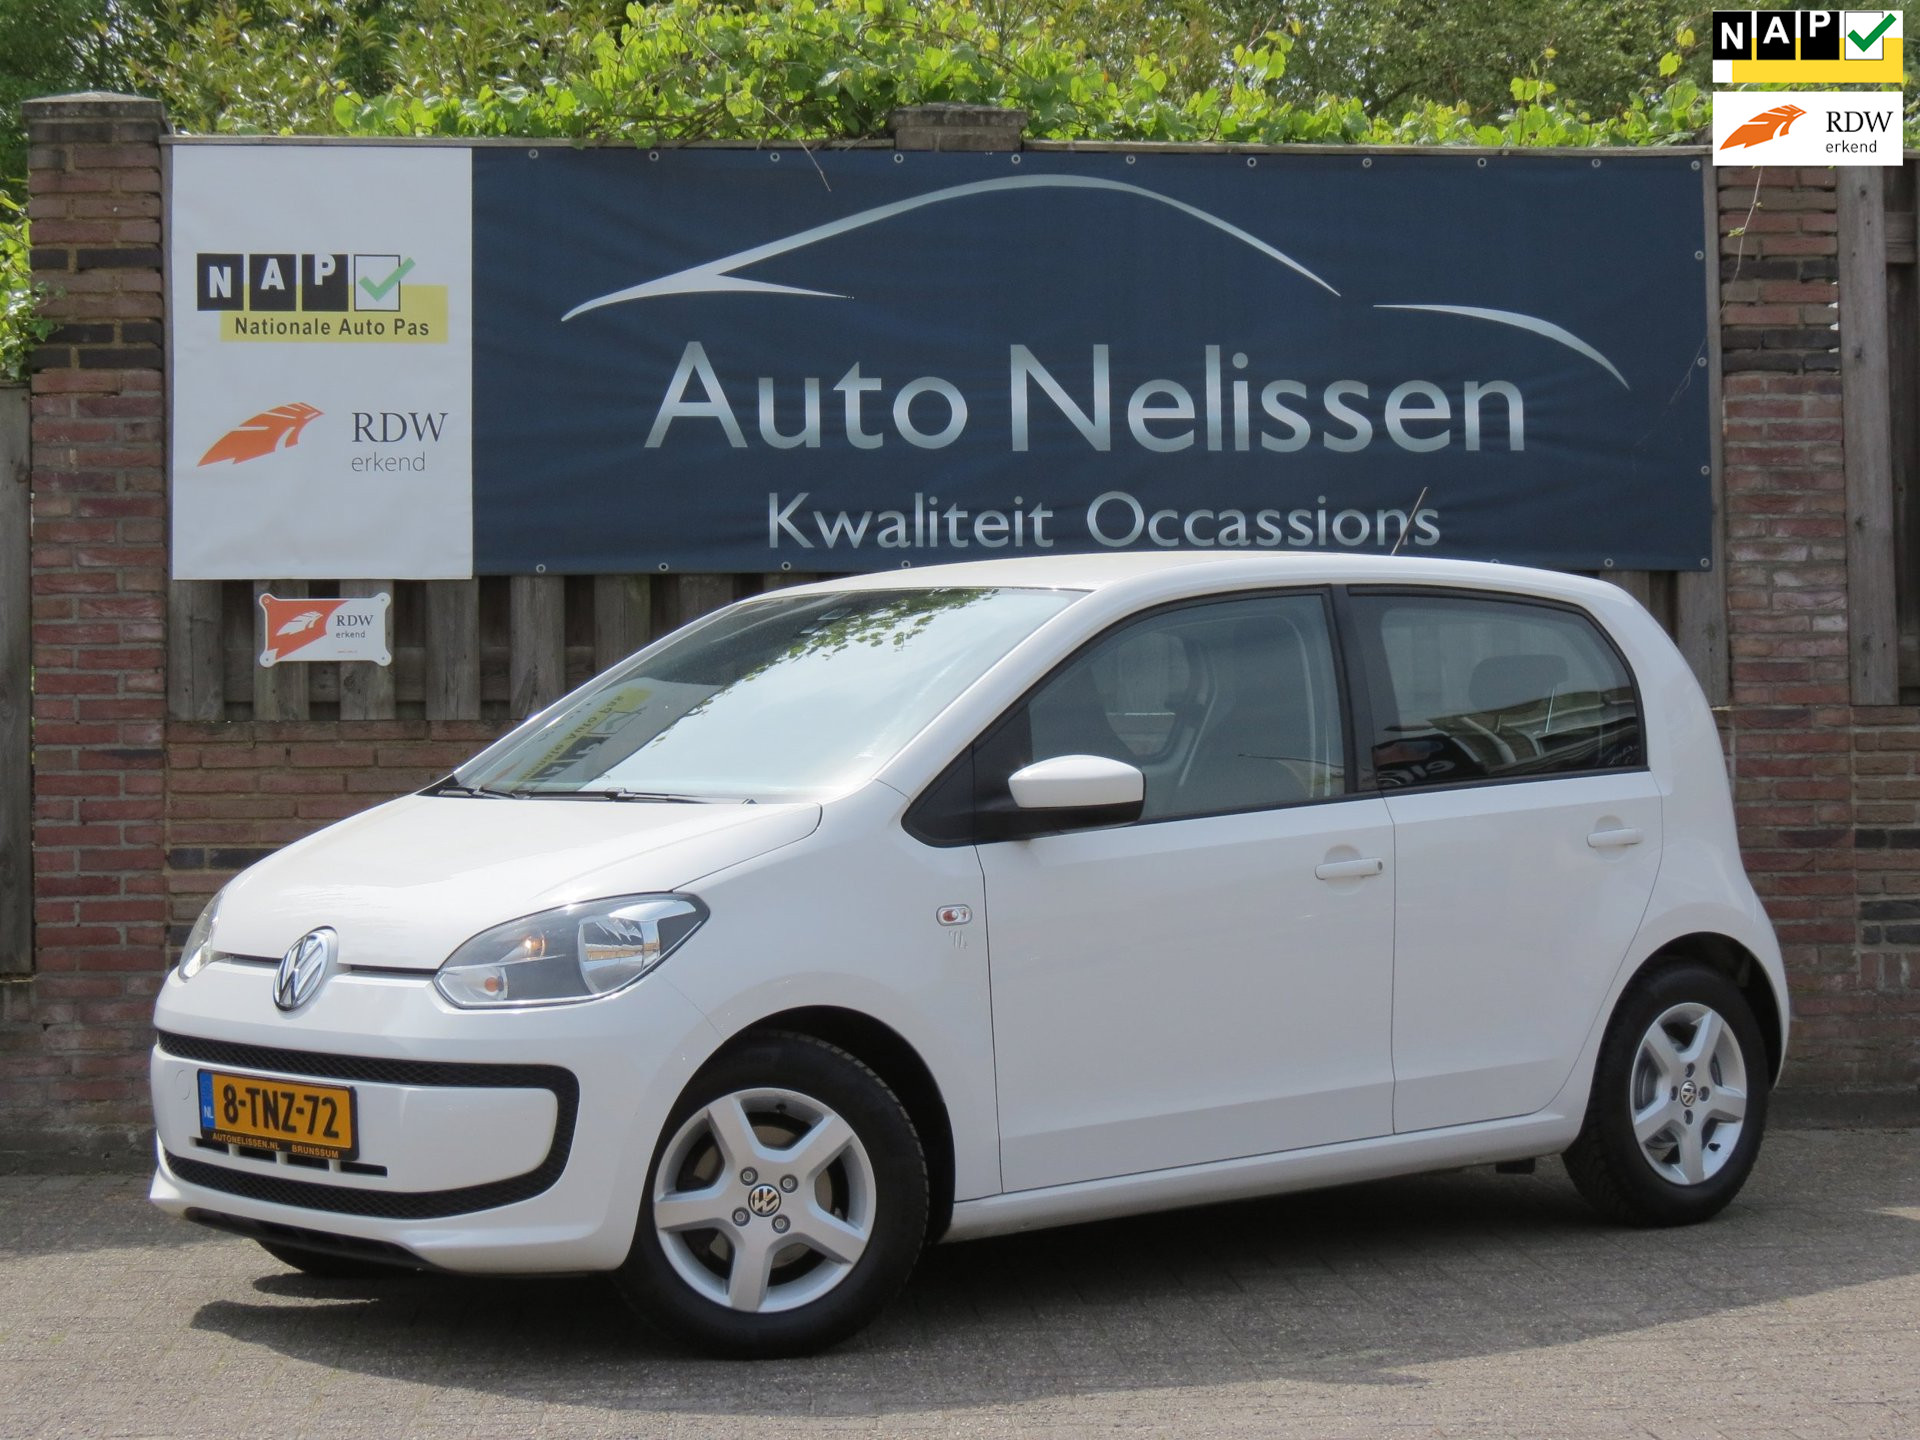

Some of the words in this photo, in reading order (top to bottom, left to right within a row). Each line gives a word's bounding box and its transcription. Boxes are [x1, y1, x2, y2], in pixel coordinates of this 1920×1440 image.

[209, 250, 336, 298] NAP
[235, 317, 331, 335] Nationale
[338, 318, 385, 335] Auto
[394, 319, 429, 336] Pas
[645, 341, 968, 449] Auto
[1010, 344, 1524, 453] Nelissen
[352, 412, 449, 443] RDW
[351, 452, 426, 472] erkend
[769, 492, 1054, 549] Kwaliteit
[1086, 490, 1440, 547] Occassions
[336, 614, 373, 627] RDW
[335, 630, 366, 639] erkend
[204, 1106, 214, 1118] NL
[223, 1083, 339, 1138] 8-TNZ-72
[212, 1132, 280, 1151] AUTONELISSEN.NL
[291, 1144, 339, 1159] BRUNSSUM
